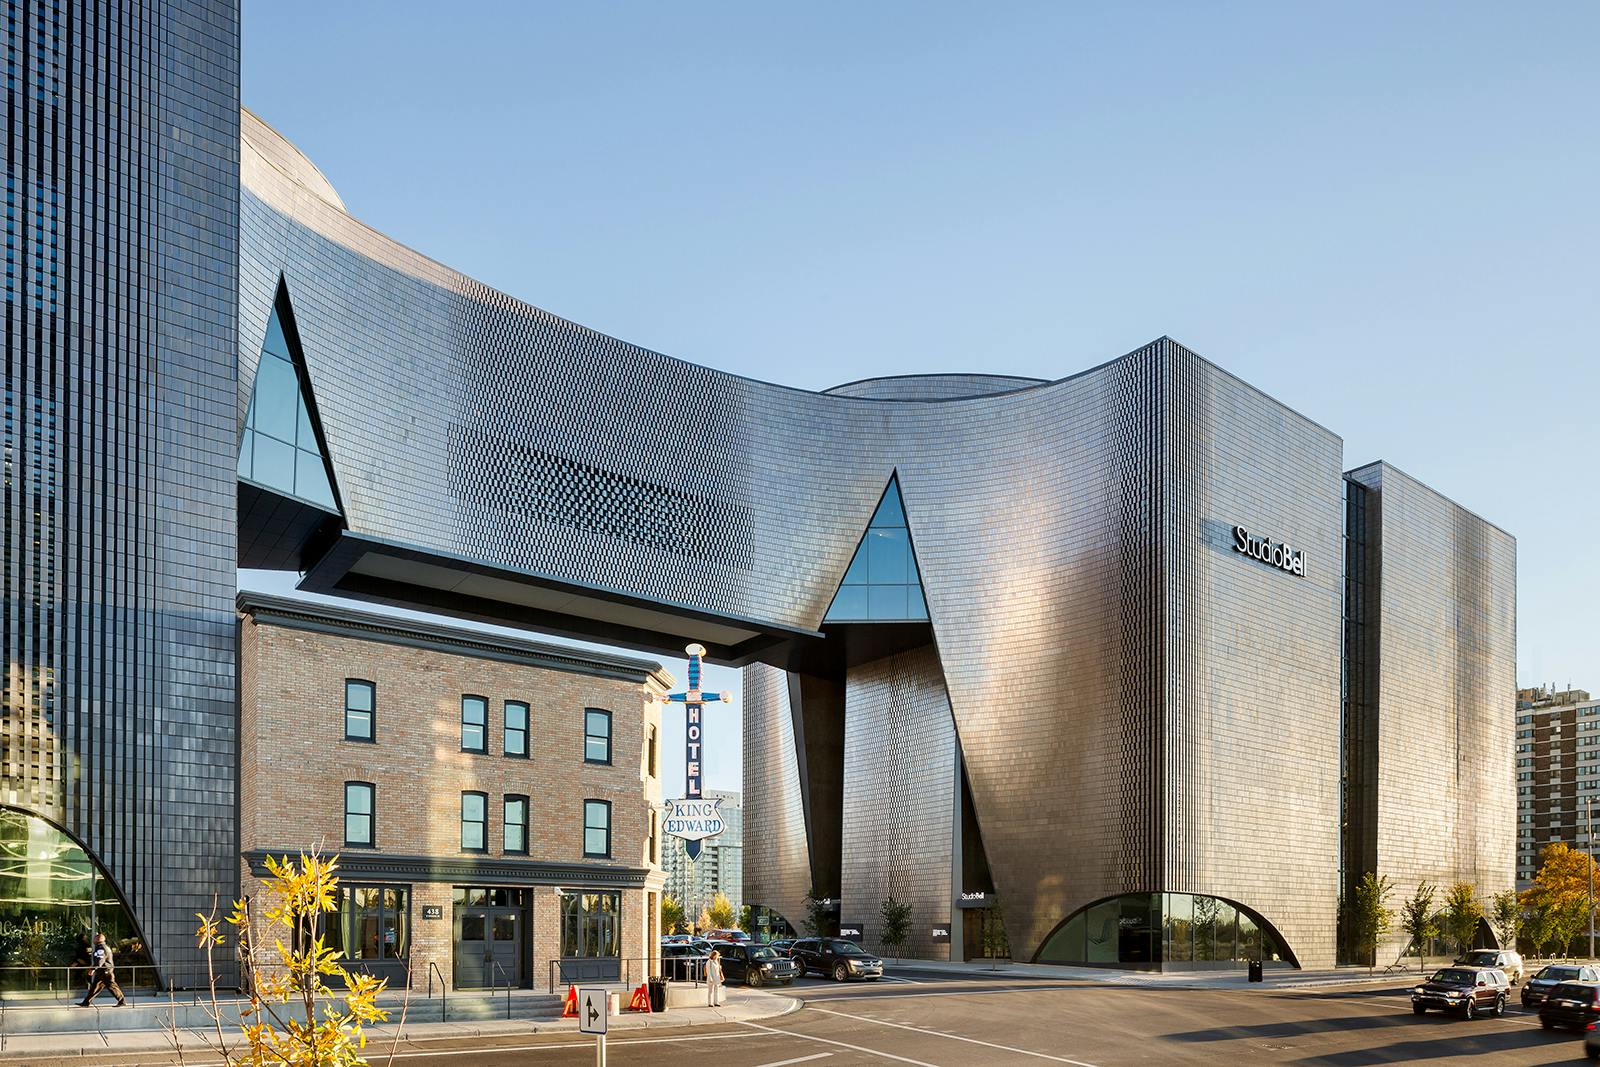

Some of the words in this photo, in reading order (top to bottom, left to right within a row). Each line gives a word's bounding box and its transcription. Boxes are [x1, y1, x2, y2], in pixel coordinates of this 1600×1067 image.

[1234, 525, 1307, 577] StudioBell
[687, 708, 700, 795] HOTEL
[668, 820, 721, 832] EDWARD
[675, 804, 712, 816] KING
